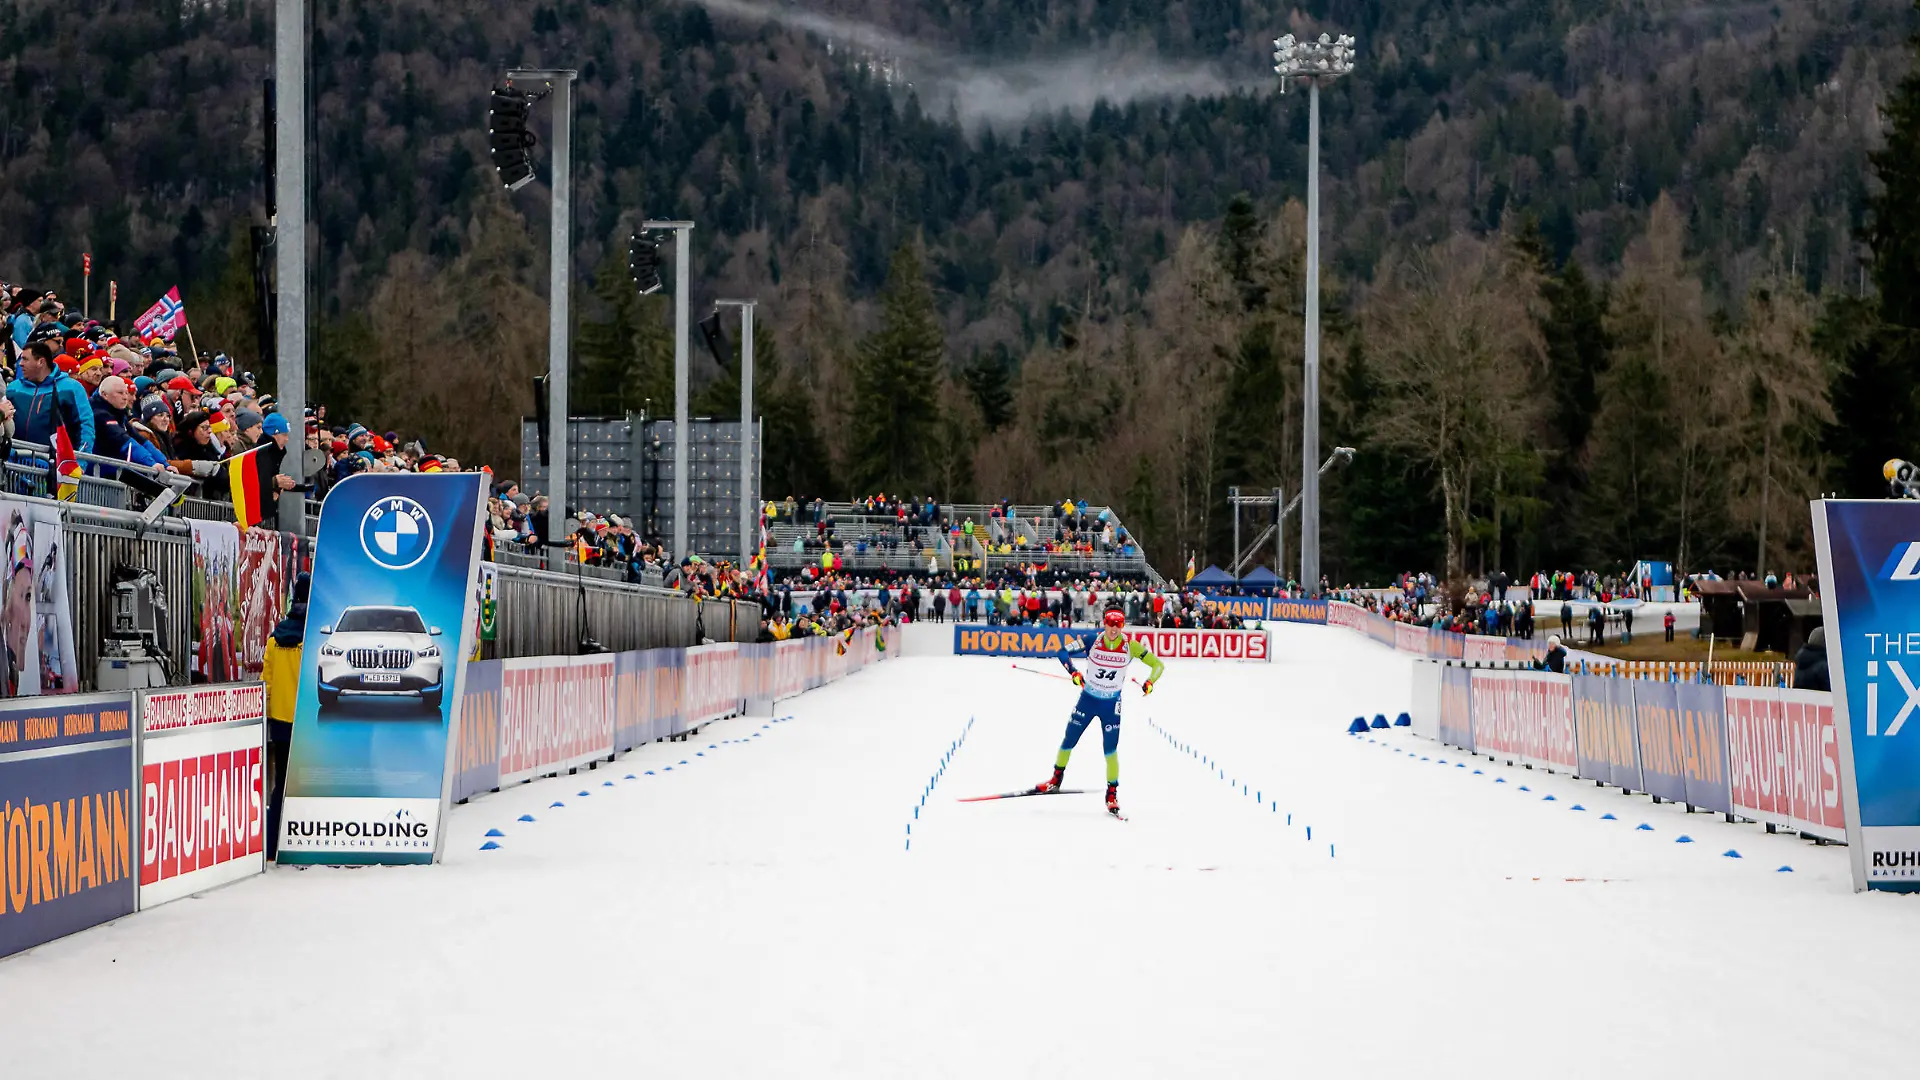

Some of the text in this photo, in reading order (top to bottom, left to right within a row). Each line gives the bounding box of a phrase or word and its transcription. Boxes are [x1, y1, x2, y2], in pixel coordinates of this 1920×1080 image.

[370, 499, 424, 521] BMW
[1202, 600, 1263, 618] RMANN
[1272, 601, 1326, 621] HÖRMANN
[960, 629, 1082, 653] HÖRMAN
[1135, 633, 1266, 657] AUHAUS
[1864, 633, 1920, 655] THE
[1095, 668, 1117, 681] 34
[150, 687, 263, 731] BAUHAUS BAUHAUS BAUHAUS
[501, 680, 566, 757] BAUHAUS
[0, 710, 128, 744] MANN HÖRMANN HÖRMANN HÖRMANN
[1727, 713, 1839, 809] BAUHAUS
[143, 763, 261, 866] BAUHAUS
[287, 821, 428, 838] RUHPOLDING
[287, 838, 375, 847] BAYERISCHE
[1872, 851, 1920, 866] RUH
